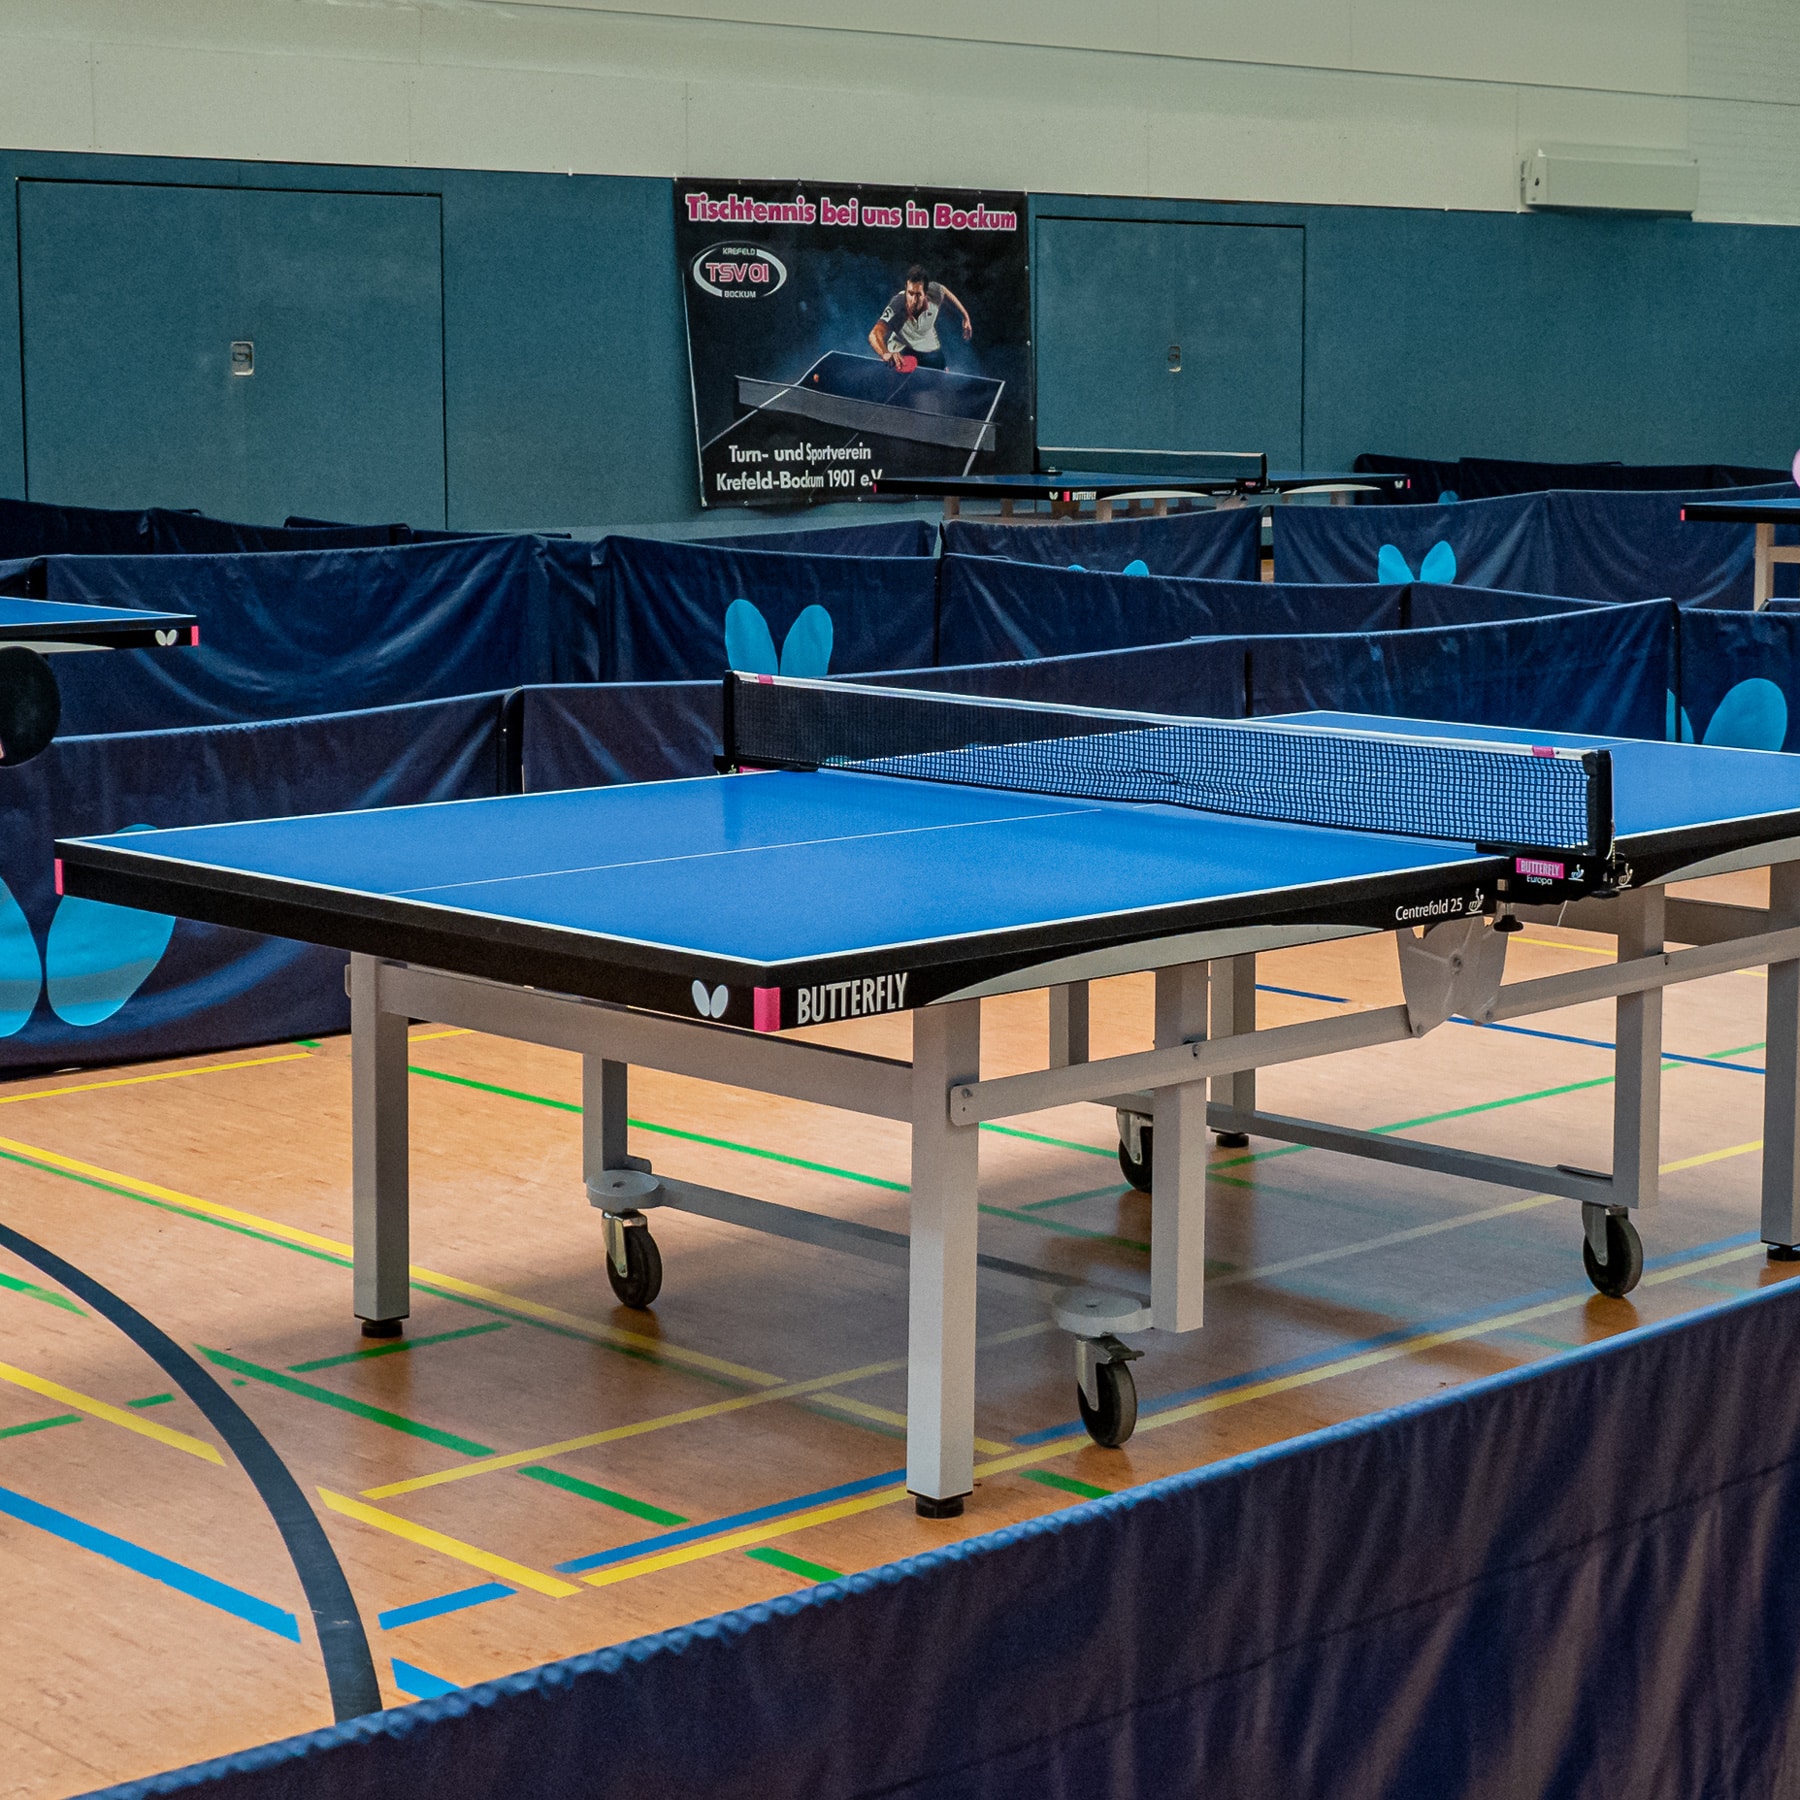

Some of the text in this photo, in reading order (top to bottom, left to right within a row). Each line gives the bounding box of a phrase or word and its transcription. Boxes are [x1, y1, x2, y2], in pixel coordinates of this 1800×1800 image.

[685, 191, 1017, 231] Tischtennis bei uns in Bockum
[722, 247, 756, 256] KREFELD
[724, 290, 757, 298] BOCKUM
[728, 442, 871, 465] Turn- und Sportverein
[716, 470, 824, 491] Krefeld-Bockum
[827, 469, 855, 487] 1901
[1520, 860, 1560, 876] BUTTERFLY
[1526, 875, 1553, 886] Europa
[1395, 898, 1449, 921] Centrefold
[1450, 897, 1463, 913] 25
[797, 972, 908, 1025] BUTTERFLY
